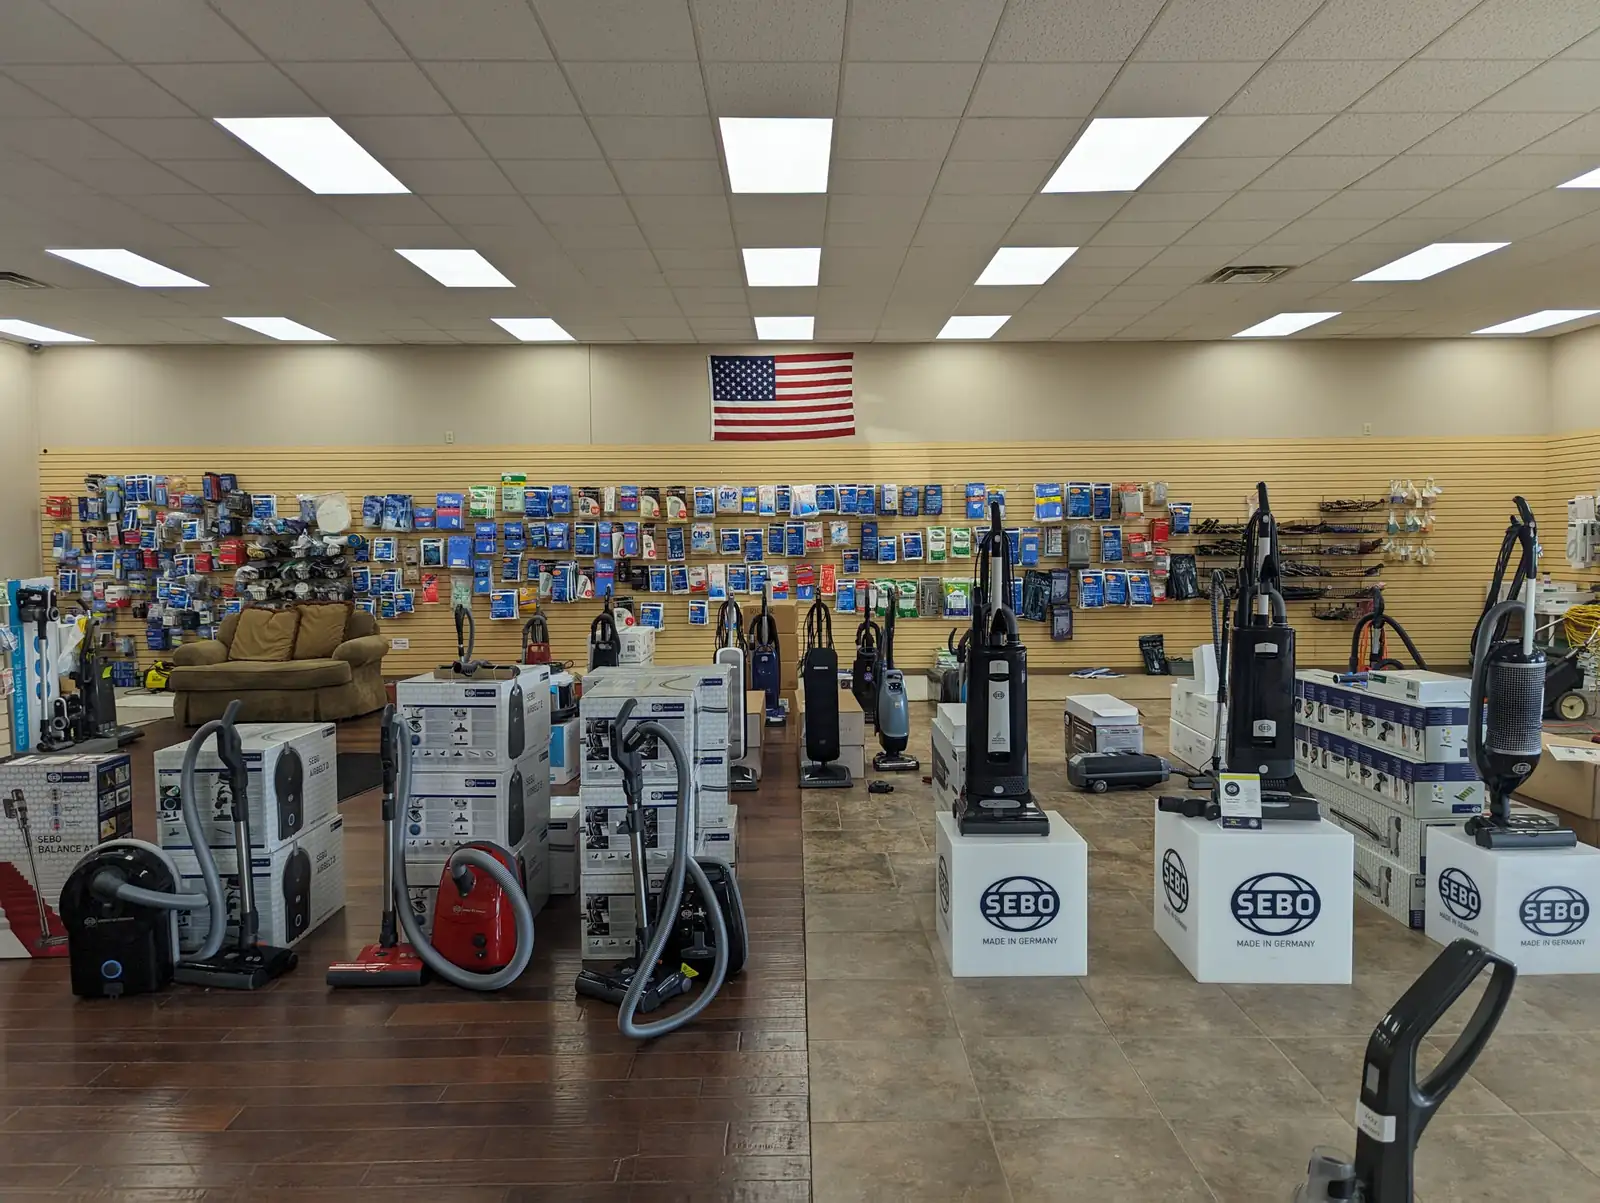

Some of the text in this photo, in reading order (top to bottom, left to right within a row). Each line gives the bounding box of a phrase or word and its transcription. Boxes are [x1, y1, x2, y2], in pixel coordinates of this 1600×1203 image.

[720, 491, 737, 500] CN-2
[692, 530, 710, 539] CN-3
[37, 835, 62, 843] SEBO
[38, 844, 82, 853] BALANCE
[1164, 861, 1187, 901] SEBO
[1441, 878, 1478, 910] SEBO
[986, 894, 1055, 914] SEBO
[1237, 893, 1314, 915] SEBO
[1524, 902, 1585, 920] SEBO
